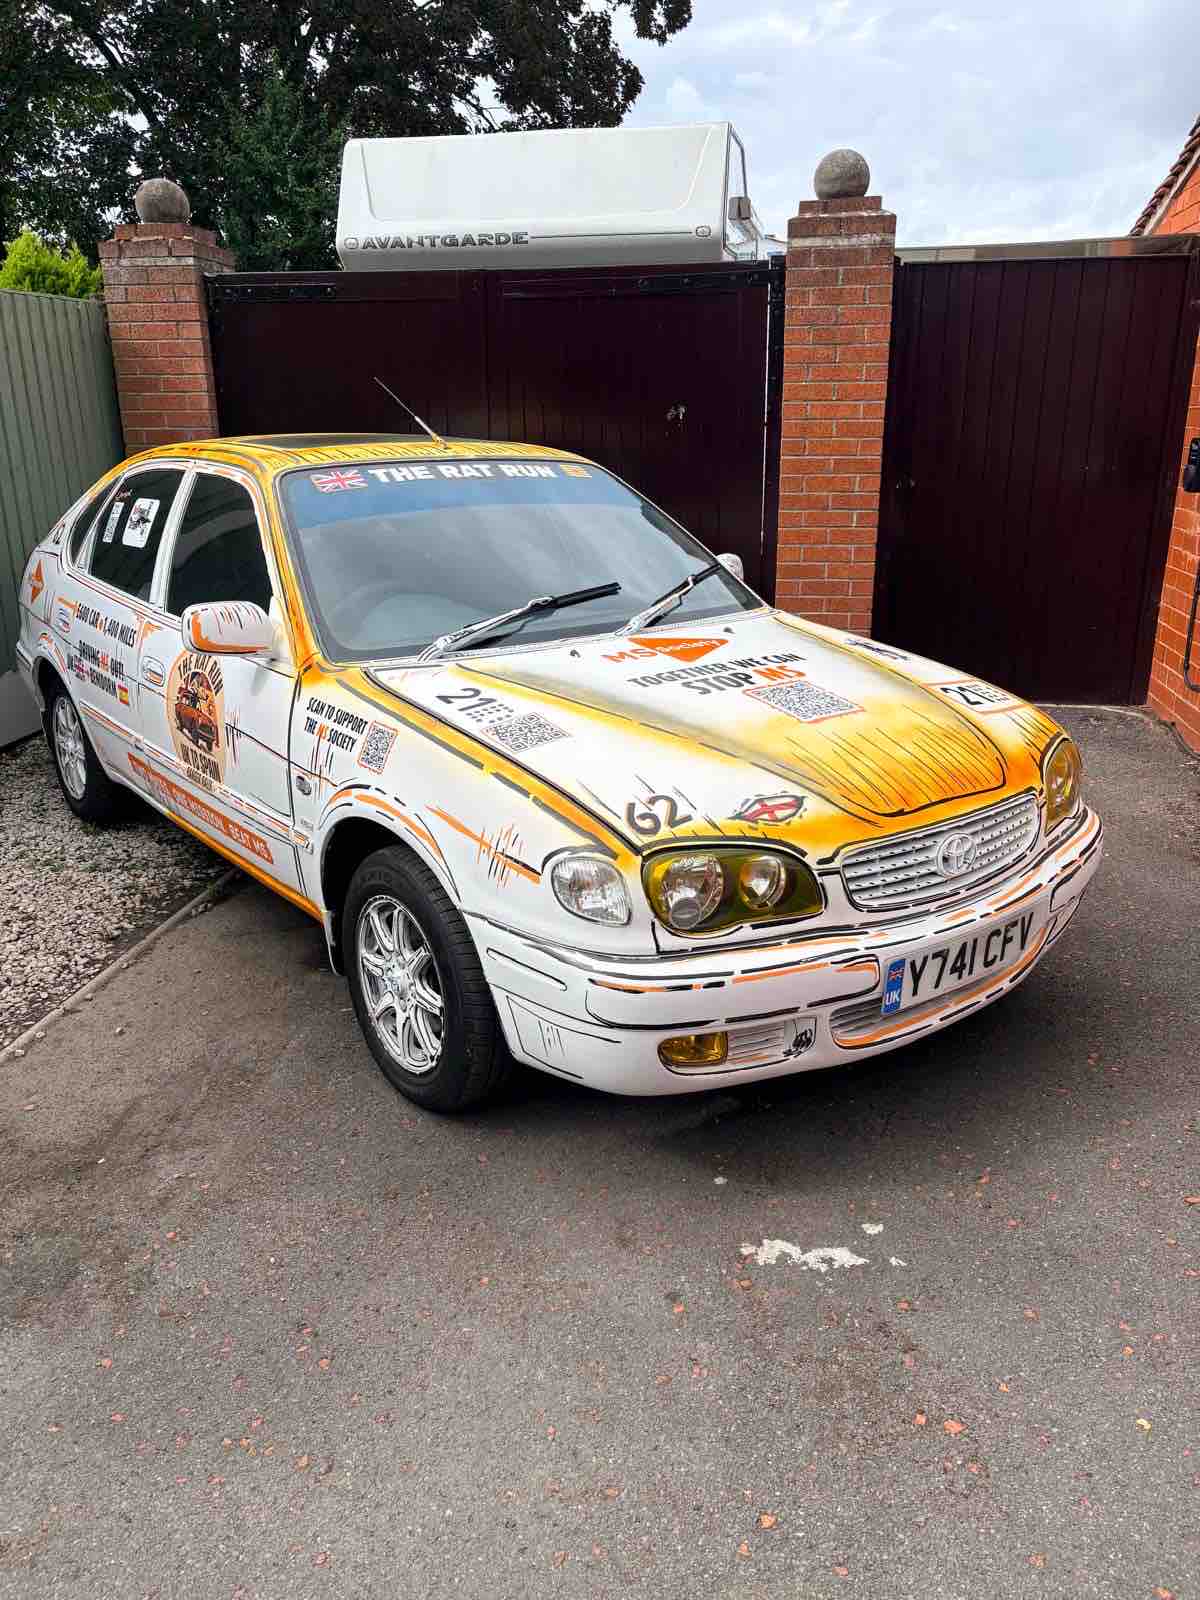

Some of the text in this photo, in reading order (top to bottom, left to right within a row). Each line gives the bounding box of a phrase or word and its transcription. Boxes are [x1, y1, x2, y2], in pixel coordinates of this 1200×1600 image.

[362, 232, 528, 249] AVANTGARDE
[368, 463, 558, 483] THE RAT RUN
[118, 623, 137, 648] MILES
[600, 648, 658, 662] MS
[178, 654, 224, 696] THE RAT RUN
[627, 653, 806, 688] TOGETHER WE CAN
[682, 665, 806, 695] STOP MS
[436, 688, 497, 711] 21
[940, 685, 996, 706] 21
[306, 697, 368, 735] SCAN TO SUPPORT
[304, 716, 357, 752] THE MS SOCIETY
[199, 752, 222, 784] SPAIN
[624, 794, 693, 835] 62
[909, 911, 1034, 998] Y741 CFV
[885, 991, 900, 1005] UK
